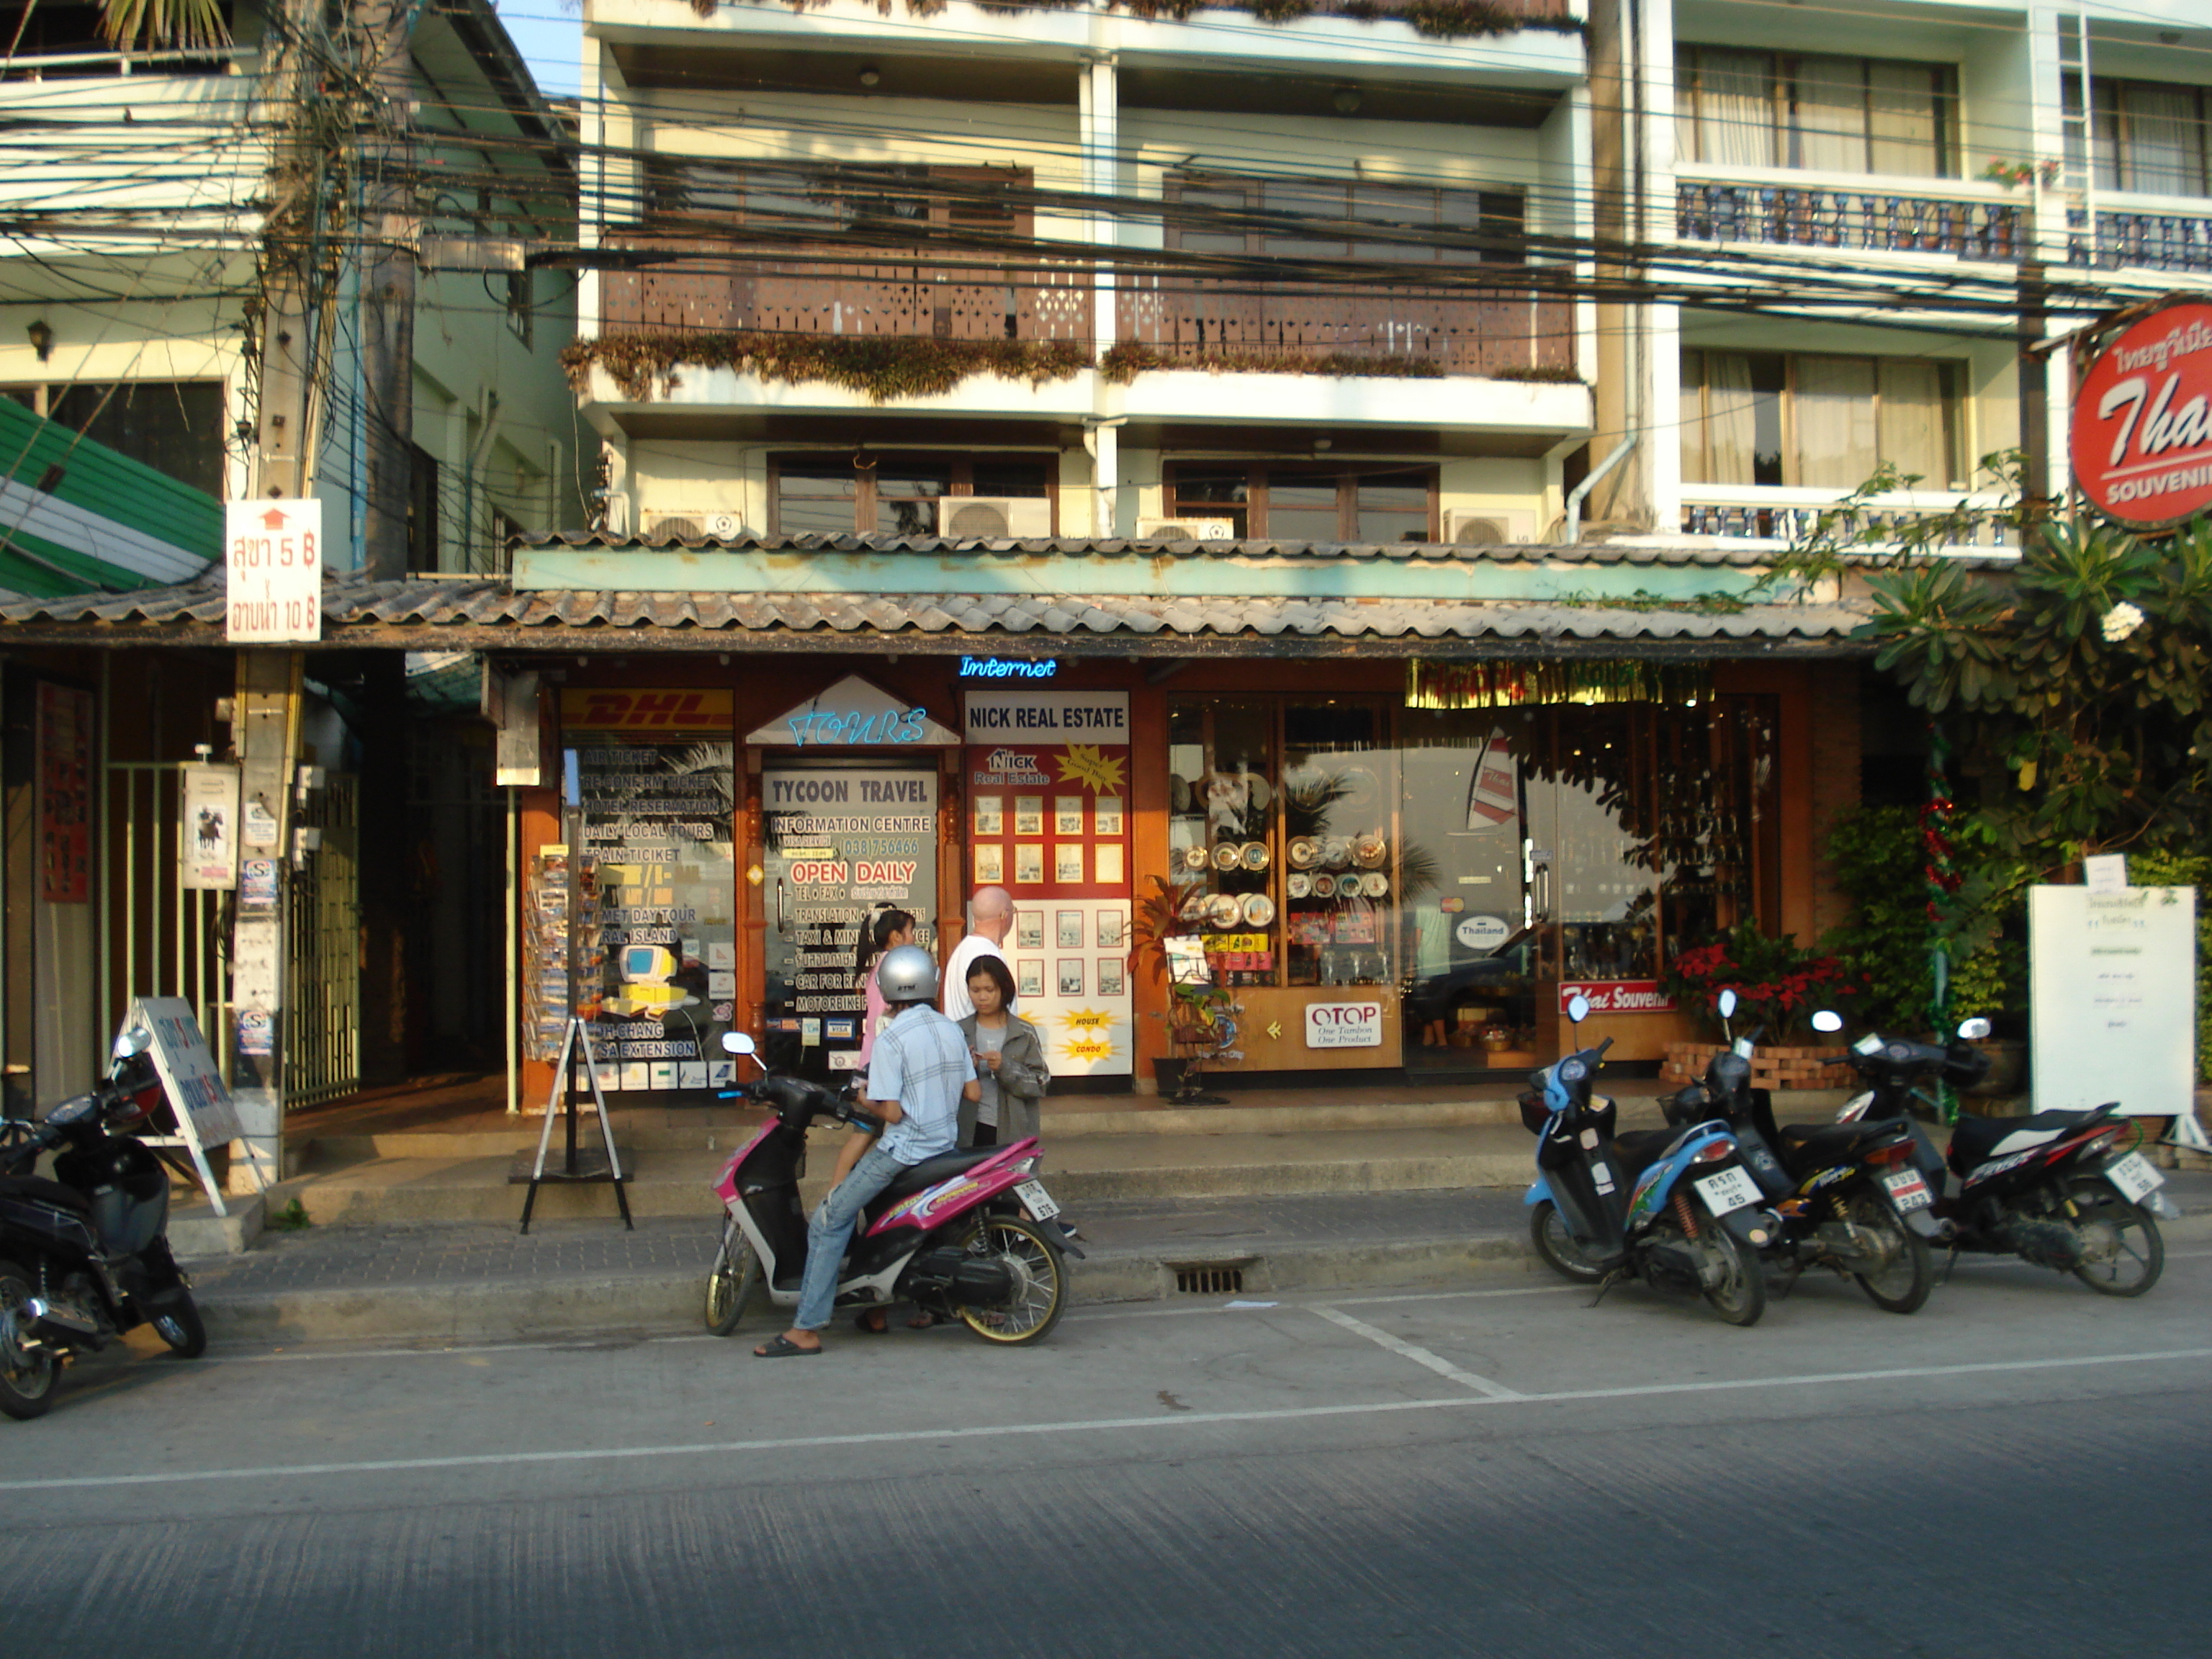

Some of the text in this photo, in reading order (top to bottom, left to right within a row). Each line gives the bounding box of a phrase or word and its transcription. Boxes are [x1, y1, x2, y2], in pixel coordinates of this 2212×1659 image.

[2106, 464, 2212, 505] SOUVENI
[280, 537, 294, 567] 5
[285, 601, 301, 631] 10
[960, 655, 1056, 677] Internet
[583, 693, 711, 725] DHL
[970, 707, 1125, 728] NICK REAL ESTATE
[788, 707, 927, 747] TOURS
[584, 750, 658, 765] AIR TICKET
[1080, 752, 1103, 768] Super
[974, 772, 1050, 785] Real Estate
[1066, 758, 1110, 783] Good Buy
[772, 780, 927, 803] TYCOON TRAVEL
[584, 799, 719, 815] HOTEL RESERVATION
[583, 822, 714, 840] DAILY LOCAL TOURS
[771, 817, 931, 833] INFORMATION CENTRE
[792, 862, 917, 884] OPEN DAILY
[795, 886, 839, 900] TEL FAX
[631, 908, 658, 924] DAY
[660, 908, 696, 922] TOUR
[795, 907, 860, 924] TRANSLATION
[629, 927, 678, 944] ISLAND
[796, 929, 822, 945] TAXI
[822, 929, 833, 945] &
[796, 974, 818, 990] CAR
[819, 974, 842, 989] FOR
[796, 995, 861, 1012] MOTORBIKE
[1311, 1007, 1377, 1026] OTOP
[620, 1040, 696, 1058] EXTENSION
[1728, 1193, 1746, 1208] 45
